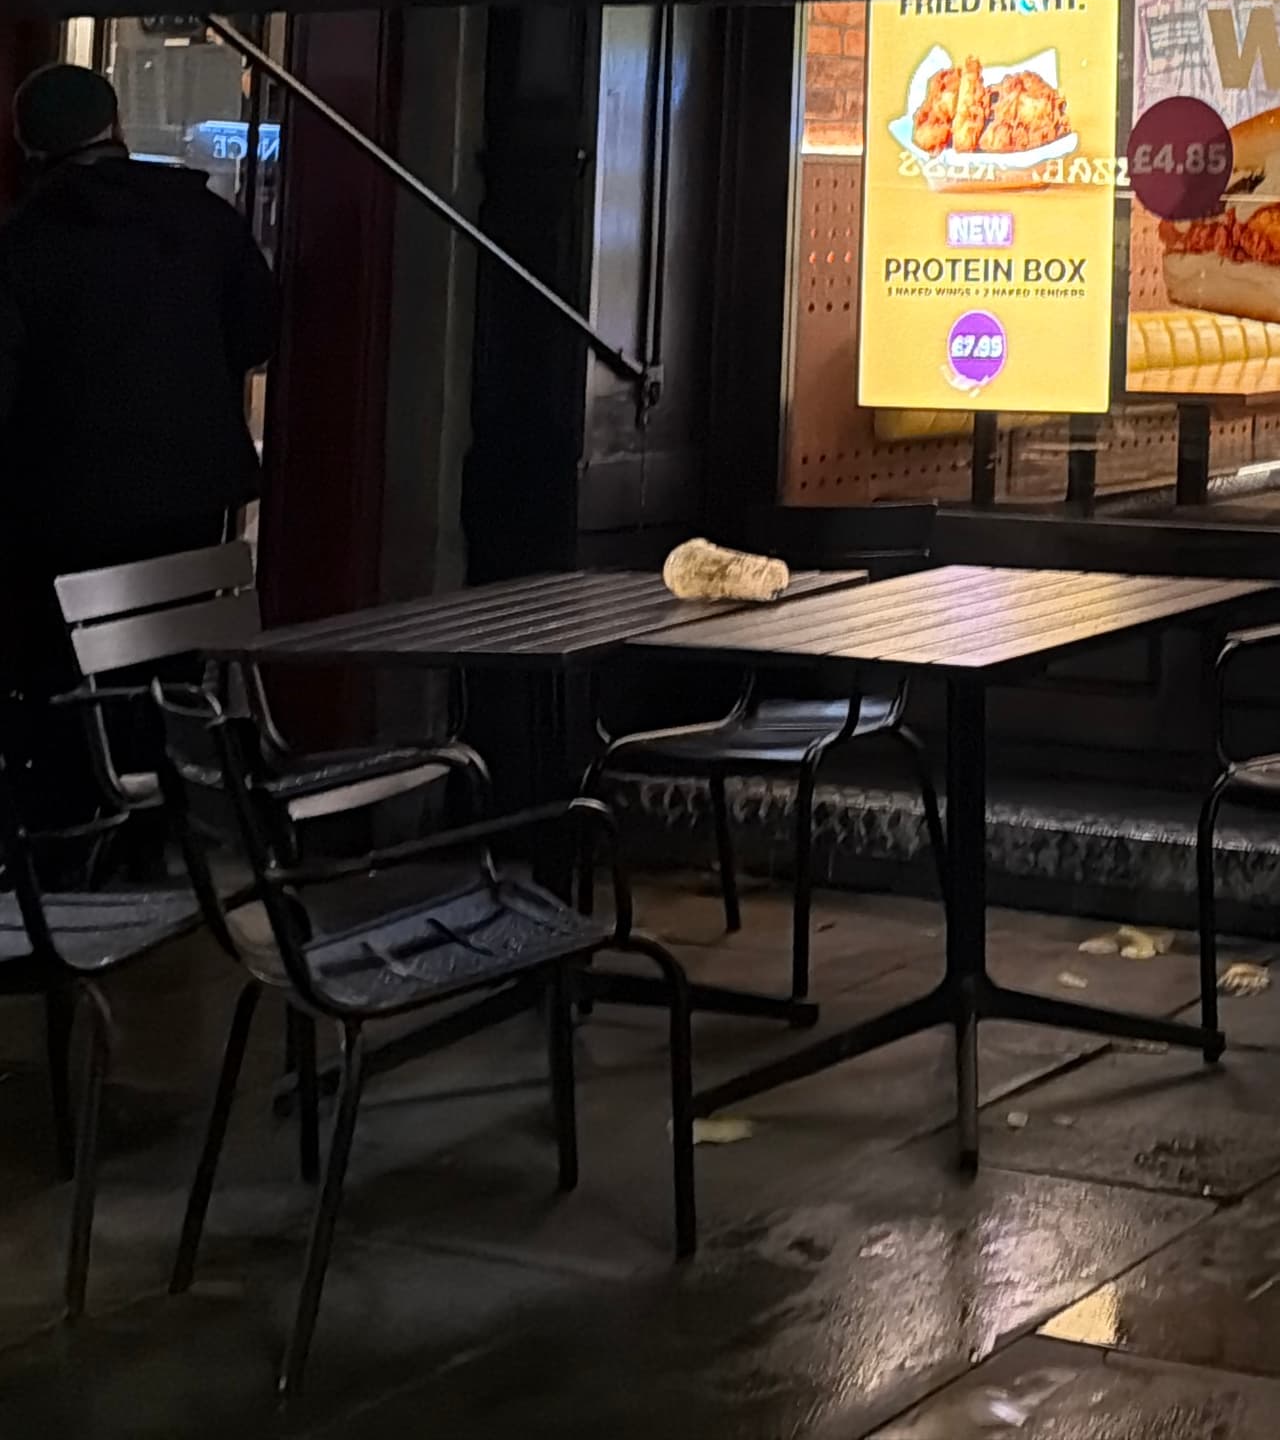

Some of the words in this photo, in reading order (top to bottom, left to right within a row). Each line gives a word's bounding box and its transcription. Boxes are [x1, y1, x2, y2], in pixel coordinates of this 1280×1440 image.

[1133, 144, 1227, 177] £4.85
[949, 215, 1010, 244] NEW
[884, 257, 1013, 283] PROTEIN
[1023, 258, 1088, 283] BOX
[895, 287, 932, 297] NAKED
[935, 287, 972, 297] WINGS
